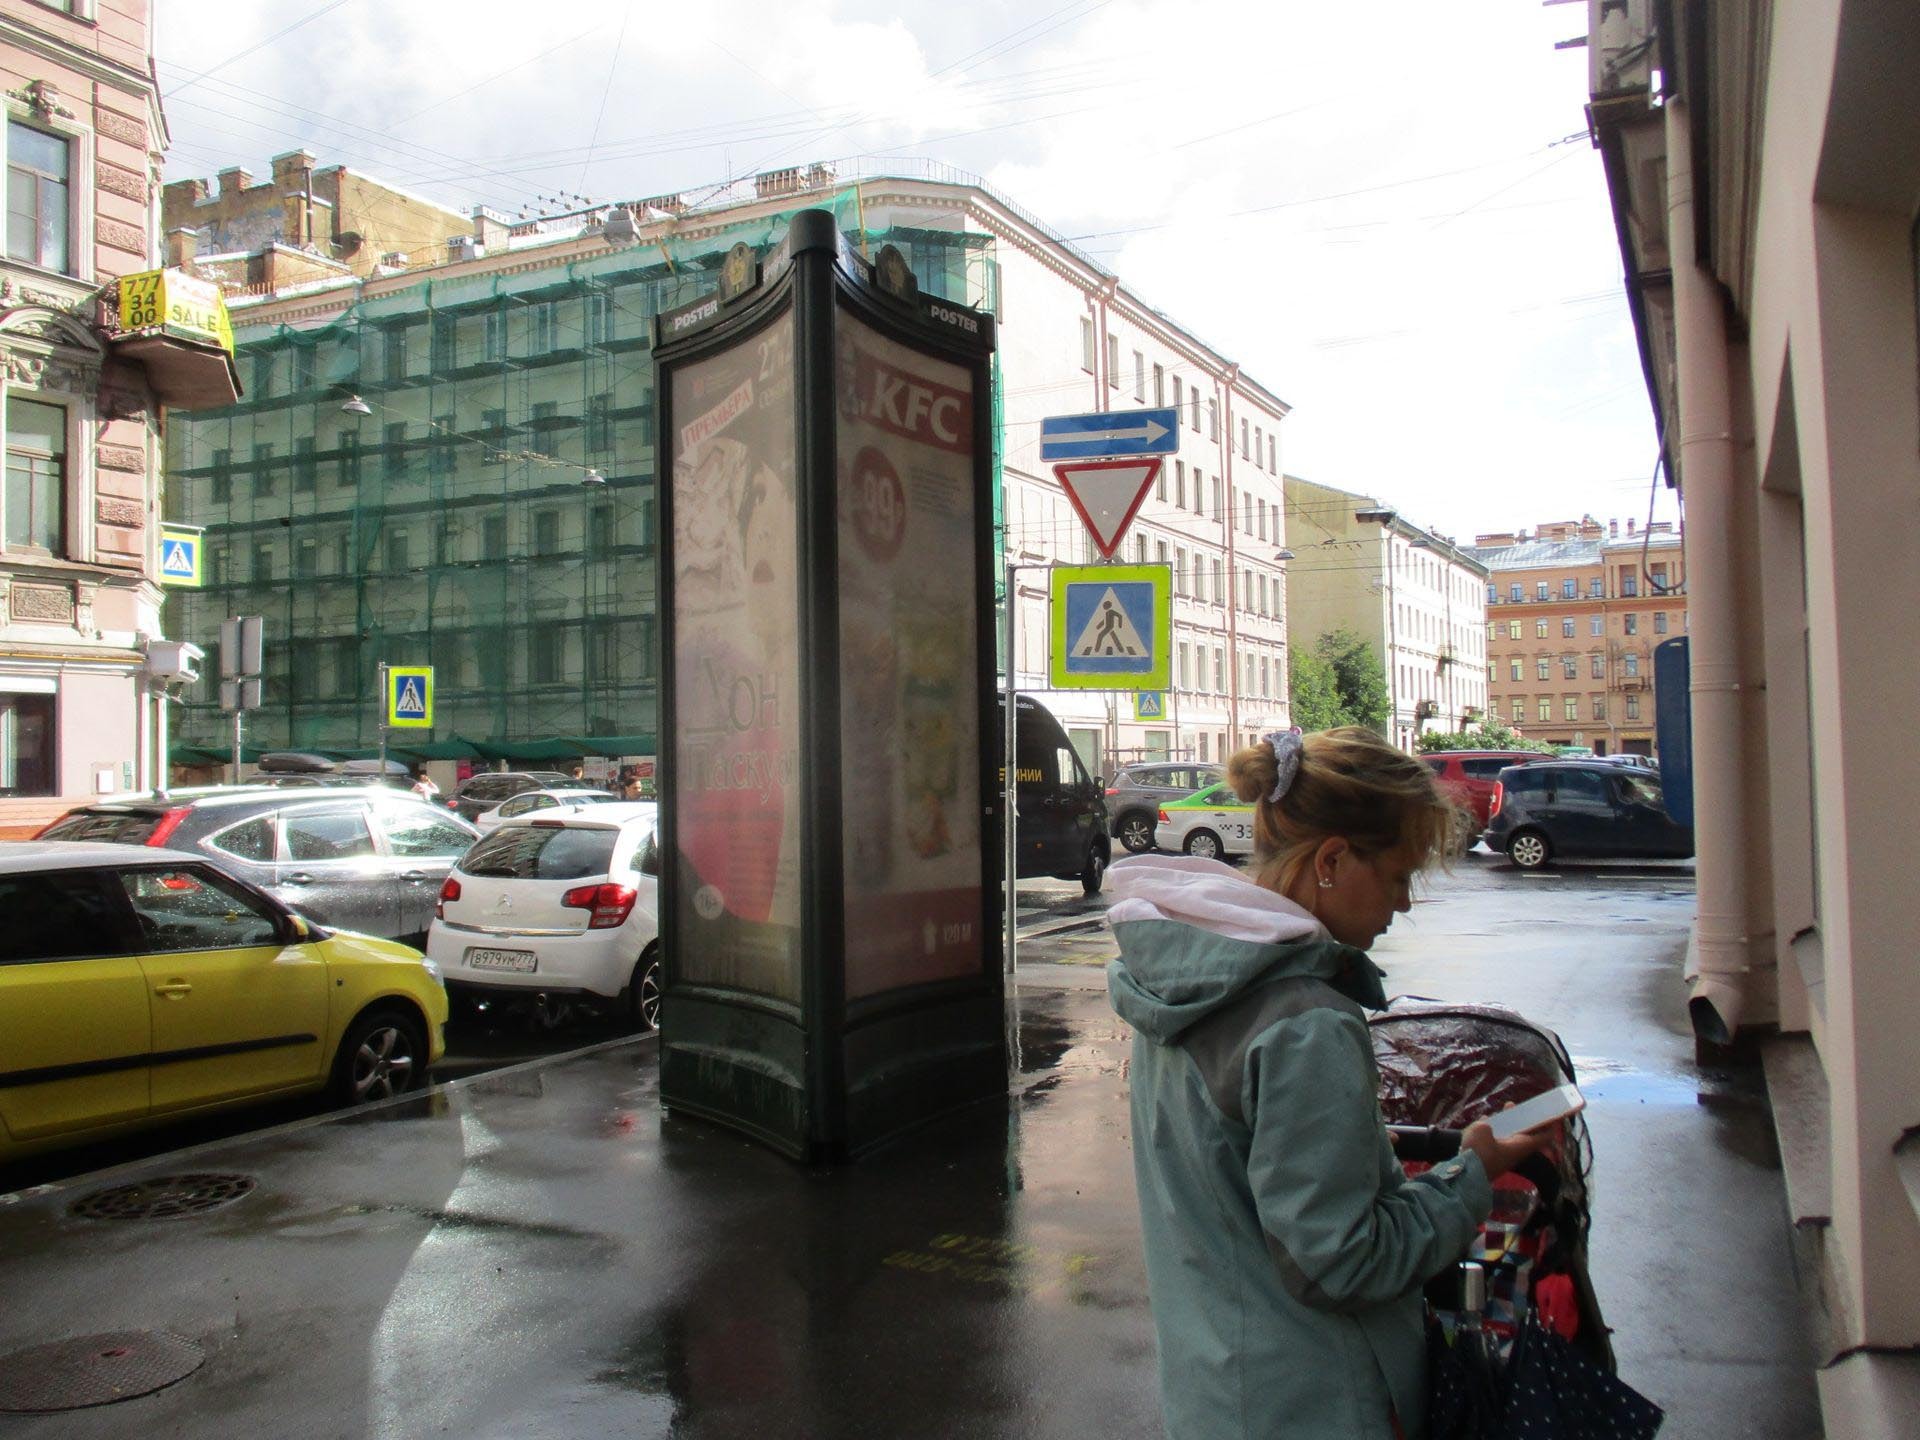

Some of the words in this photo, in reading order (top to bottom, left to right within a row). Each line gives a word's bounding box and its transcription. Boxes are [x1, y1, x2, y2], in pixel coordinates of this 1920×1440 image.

[125, 274, 160, 295] 777
[131, 291, 156, 310] 34
[132, 308, 156, 326] 00
[172, 304, 217, 332] SALE
[674, 299, 718, 331] POSTER
[931, 304, 978, 334] POSTER
[872, 369, 960, 443] KFC
